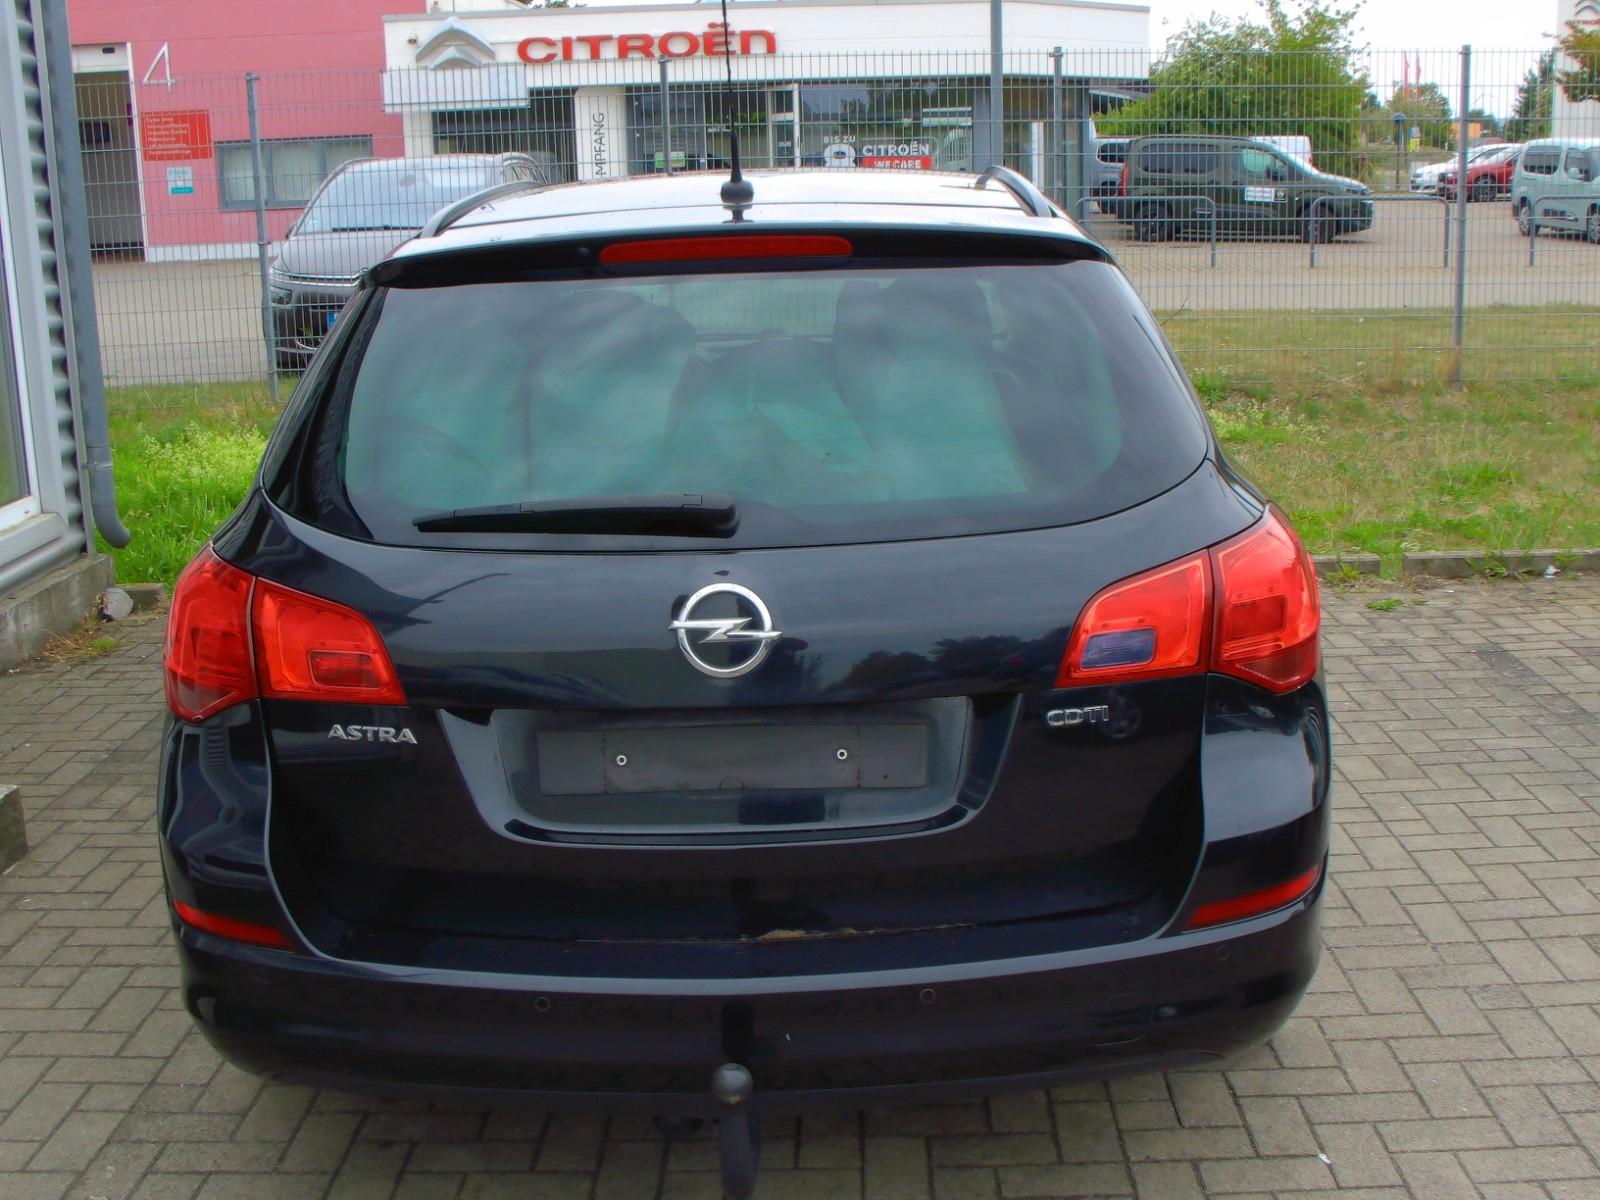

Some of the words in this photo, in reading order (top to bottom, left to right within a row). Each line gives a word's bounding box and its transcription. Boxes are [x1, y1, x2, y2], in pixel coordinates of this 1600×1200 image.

[517, 22, 777, 63] CITROËN
[143, 41, 176, 93] 4
[823, 136, 839, 144] BIS
[842, 135, 856, 143] ZU
[862, 141, 929, 156] CITROËN
[874, 160, 891, 168] WE
[893, 160, 921, 169] CARE
[328, 724, 417, 744] ASTRA
